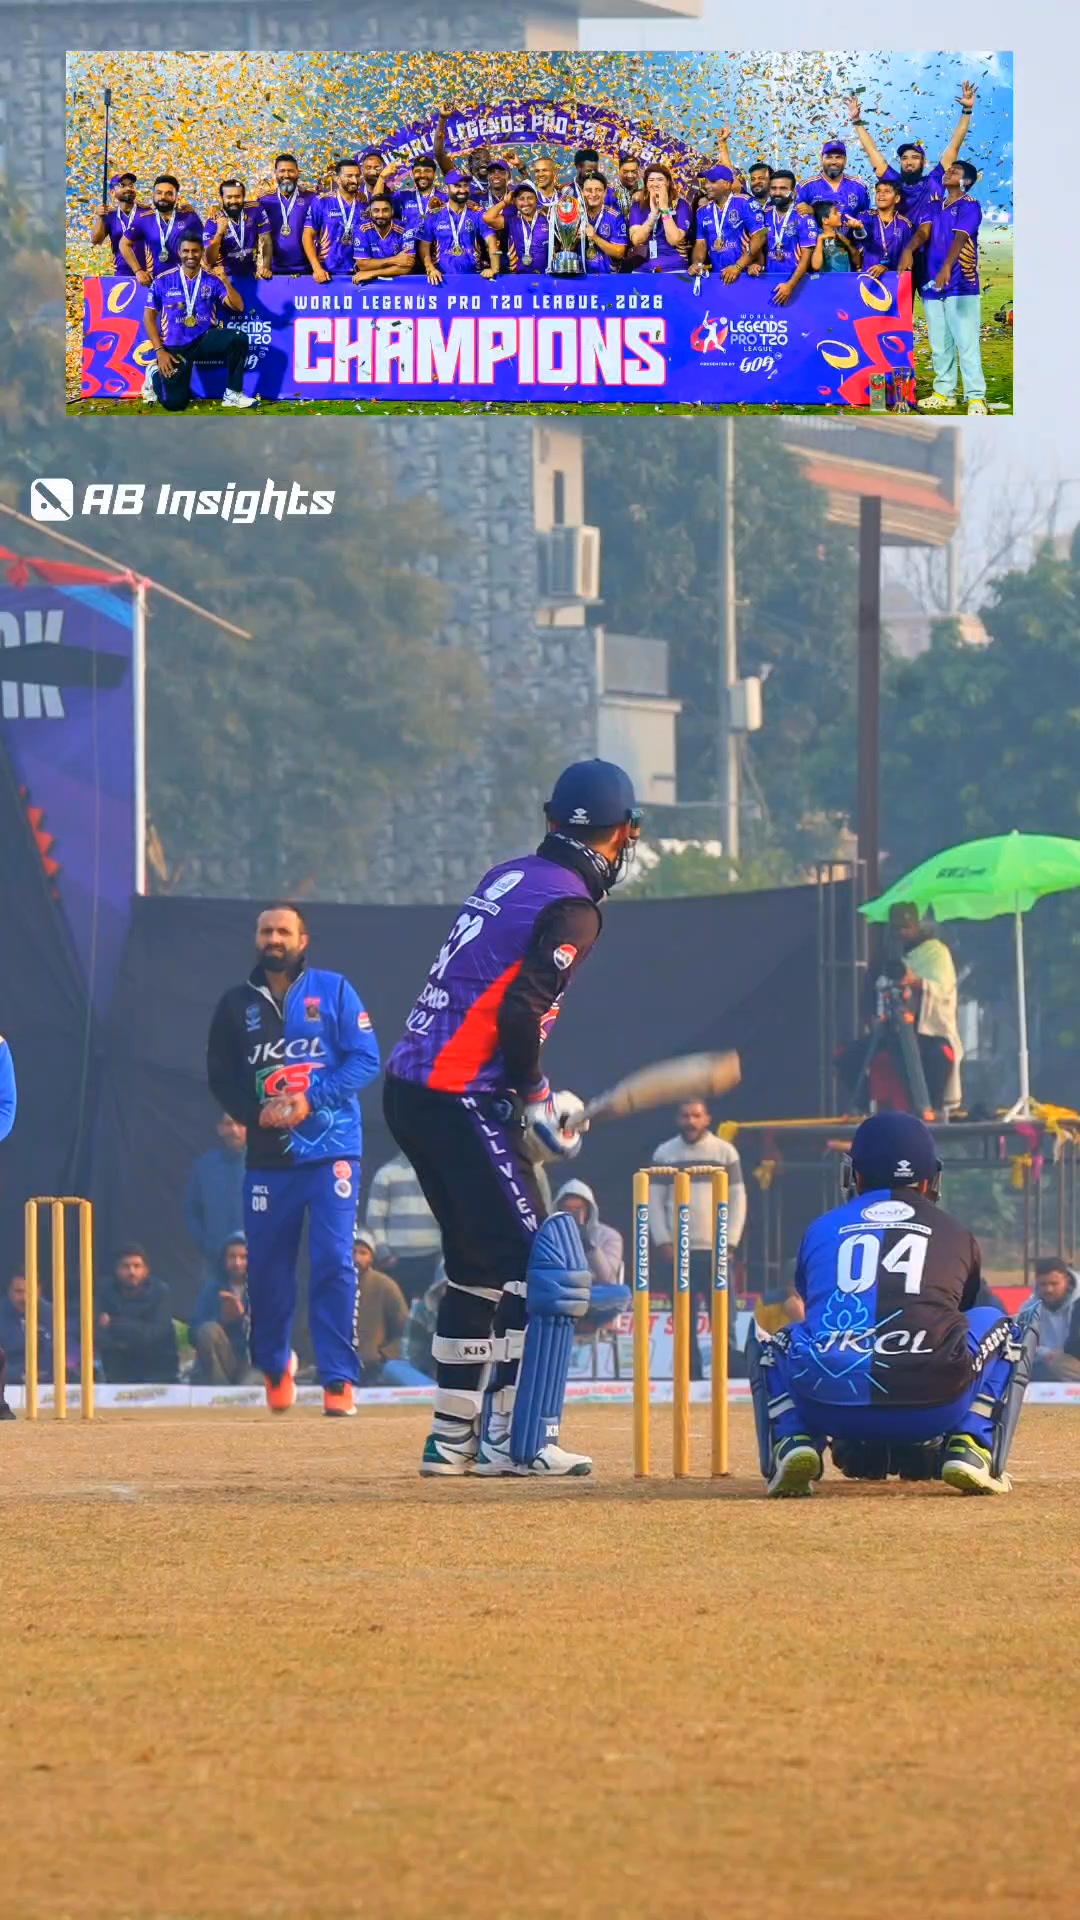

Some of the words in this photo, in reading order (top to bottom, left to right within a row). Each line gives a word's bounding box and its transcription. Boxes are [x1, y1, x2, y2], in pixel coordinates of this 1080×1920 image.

[294, 295, 352, 310] WORLD
[362, 294, 438, 310] LEGENDS
[447, 295, 481, 310] PRO
[491, 294, 523, 310] T20
[532, 294, 607, 312] LEAGUE,
[615, 294, 664, 310] 2026
[729, 320, 788, 333] LEGENDS
[730, 334, 757, 345] PRO
[759, 333, 789, 346] T20
[293, 317, 667, 385] CHAMPIONS
[247, 1036, 326, 1065] JKCL
[638, 1223, 649, 1288] VERSON
[680, 1224, 690, 1288] VERSON
[716, 1222, 728, 1288] VERSON
[837, 1232, 929, 1295] 04
[463, 1345, 488, 1356] KIS
[815, 1328, 933, 1355] JKCL
